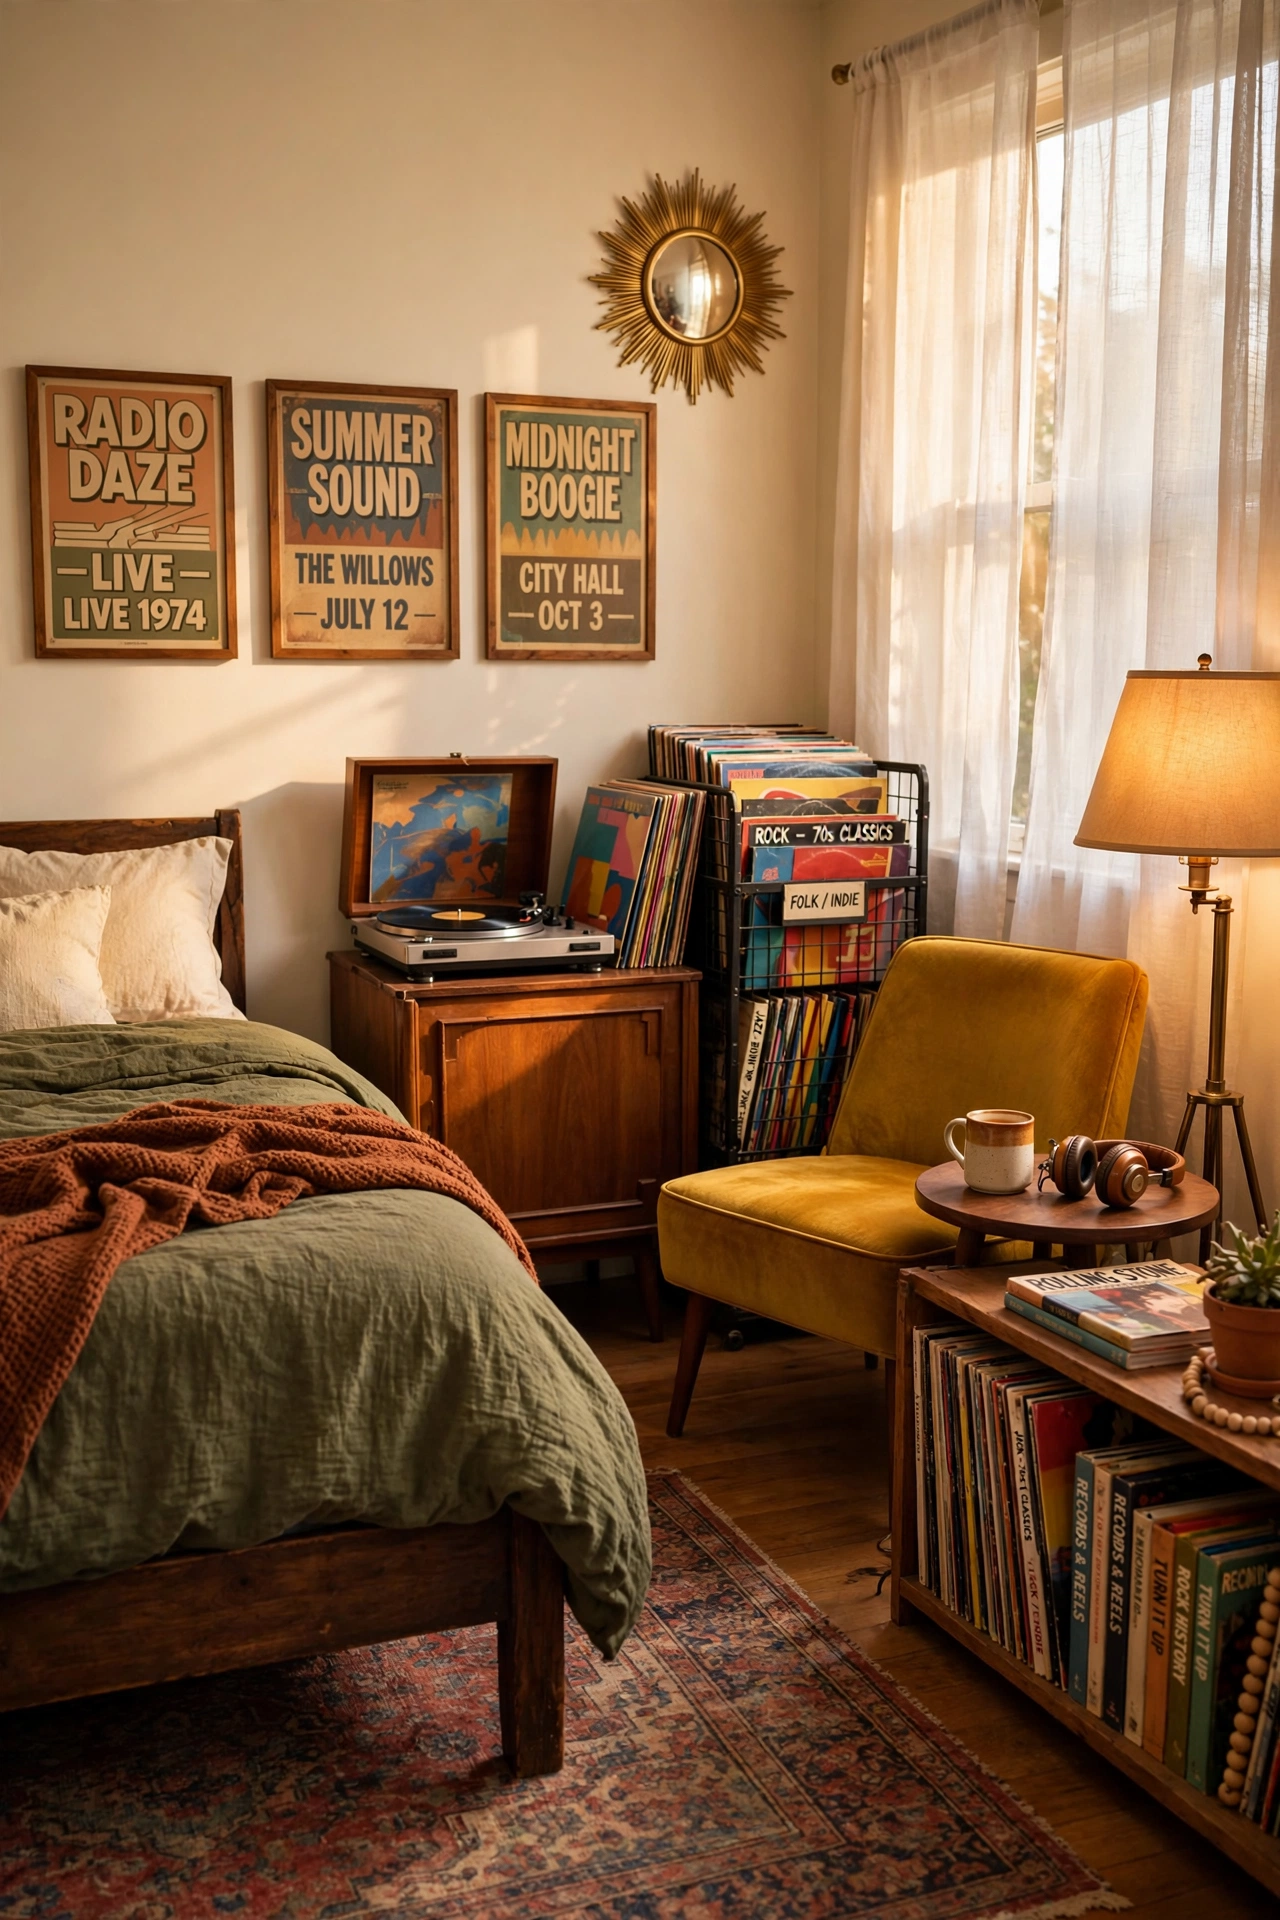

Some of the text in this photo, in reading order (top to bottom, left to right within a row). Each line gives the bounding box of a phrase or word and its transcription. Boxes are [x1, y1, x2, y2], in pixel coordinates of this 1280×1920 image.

[53, 393, 206, 452] RADIO
[291, 407, 434, 466] SUMMER
[506, 421, 636, 474] MIDNIGHT
[69, 448, 195, 505] DAZE
[308, 463, 421, 518] SOUND
[520, 472, 621, 521] BOOGIE
[92, 552, 174, 593] LIVE
[295, 553, 434, 587] THE WILLOWS
[519, 562, 624, 595] CITY HALL
[63, 597, 207, 632] LIVE 1974
[320, 597, 409, 631] JULY 12
[538, 600, 604, 632] OCT 3
[755, 826, 790, 845] ROCK
[812, 825, 834, 844] 70s
[839, 823, 893, 843] CLASSICS
[790, 892, 860, 910] FOLK / INDIE
[1025, 1262, 1188, 1292] ROLLING STONE
[1020, 1493, 1033, 1541] CLASSICS
[1072, 1476, 1089, 1623] RECORDS & REELS
[1109, 1492, 1127, 1635] RECORDS & REELS
[1151, 1557, 1168, 1656] TURN IT UP
[1172, 1564, 1191, 1687] ROCK HISTORY
[1194, 1583, 1213, 1682] TURN IT UP
